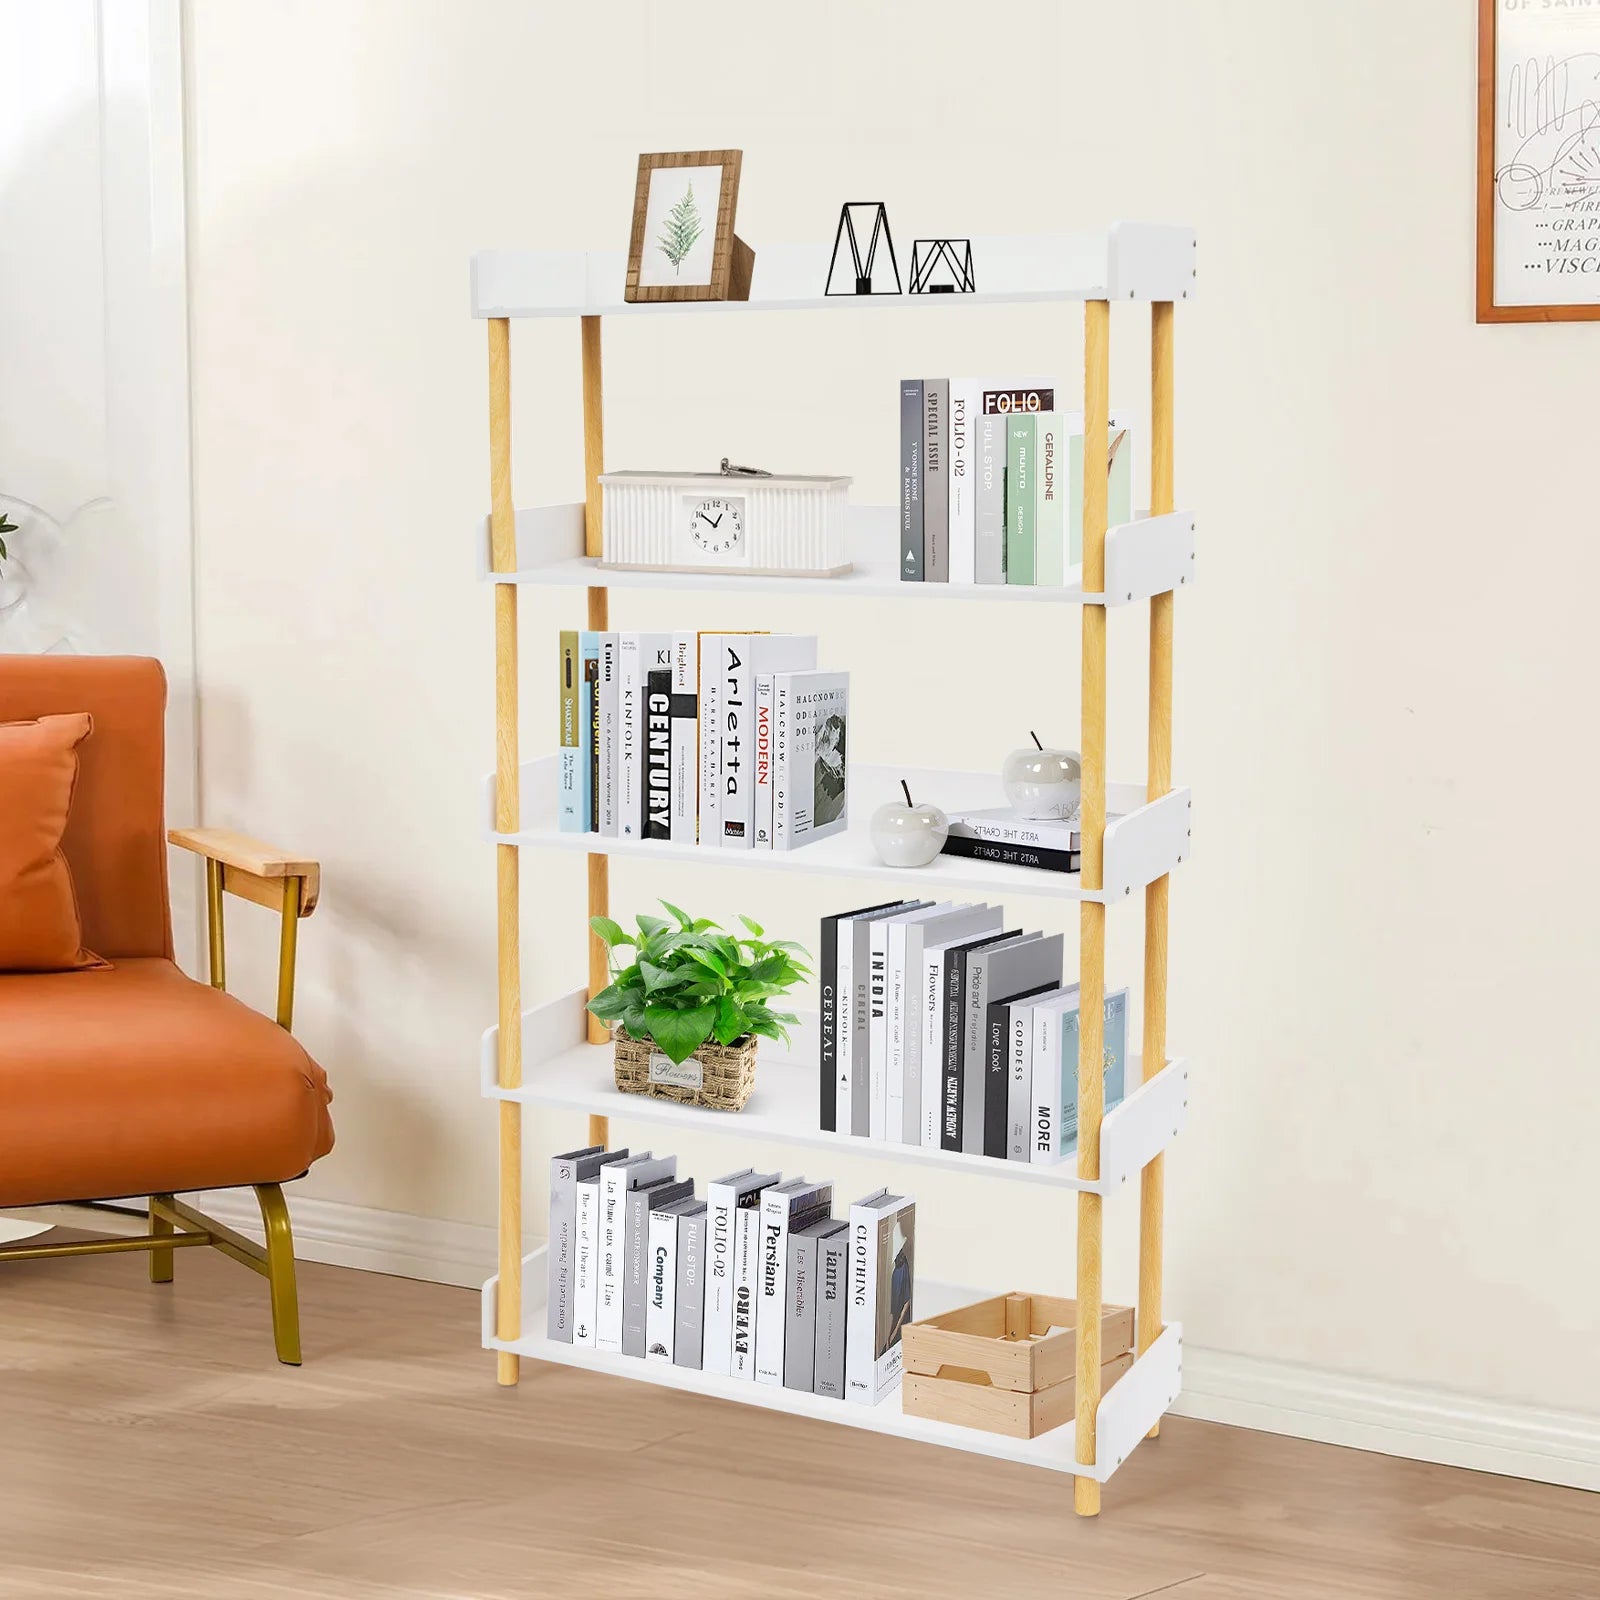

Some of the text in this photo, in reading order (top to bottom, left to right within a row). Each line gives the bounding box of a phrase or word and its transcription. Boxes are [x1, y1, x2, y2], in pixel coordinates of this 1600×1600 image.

[985, 391, 1040, 413] FOLIO
[928, 392, 939, 472] SPECIAL ISSUE
[984, 421, 992, 452] FULL
[1045, 432, 1054, 501] GERALDINE
[694, 532, 700, 540] 8
[703, 540, 708, 548] 7
[724, 541, 730, 549] 5
[604, 643, 613, 682] Union
[677, 642, 687, 687] Brightest
[624, 690, 633, 761] KINFOLK
[727, 647, 743, 796] Arletta
[758, 706, 769, 785] MODERN
[648, 692, 670, 827] CENTURY
[857, 984, 866, 1032] CEREAL
[871, 951, 884, 1019] INEDIA
[928, 964, 939, 1012] Flowers
[971, 991, 982, 1008] and
[822, 985, 834, 1062] CEREAL
[991, 1022, 1002, 1073] Love Look
[655, 1062, 698, 1081] Flowers
[1015, 1019, 1024, 1081] GODDESS
[947, 1075, 958, 1105] MARTIN
[945, 1105, 957, 1139] ANDREW
[1037, 1105, 1051, 1152] MORE
[606, 1181, 616, 1193] La
[606, 1199, 616, 1224] Dame
[606, 1228, 614, 1246] aux
[686, 1223, 697, 1287] FULL STOP.
[765, 1224, 781, 1297] Persiana
[653, 1246, 668, 1309] Company
[795, 1248, 806, 1319] Les Miserables
[825, 1249, 842, 1301] ianra
[855, 1224, 867, 1307] CLOTHING
[557, 1267, 568, 1330] Constructing
